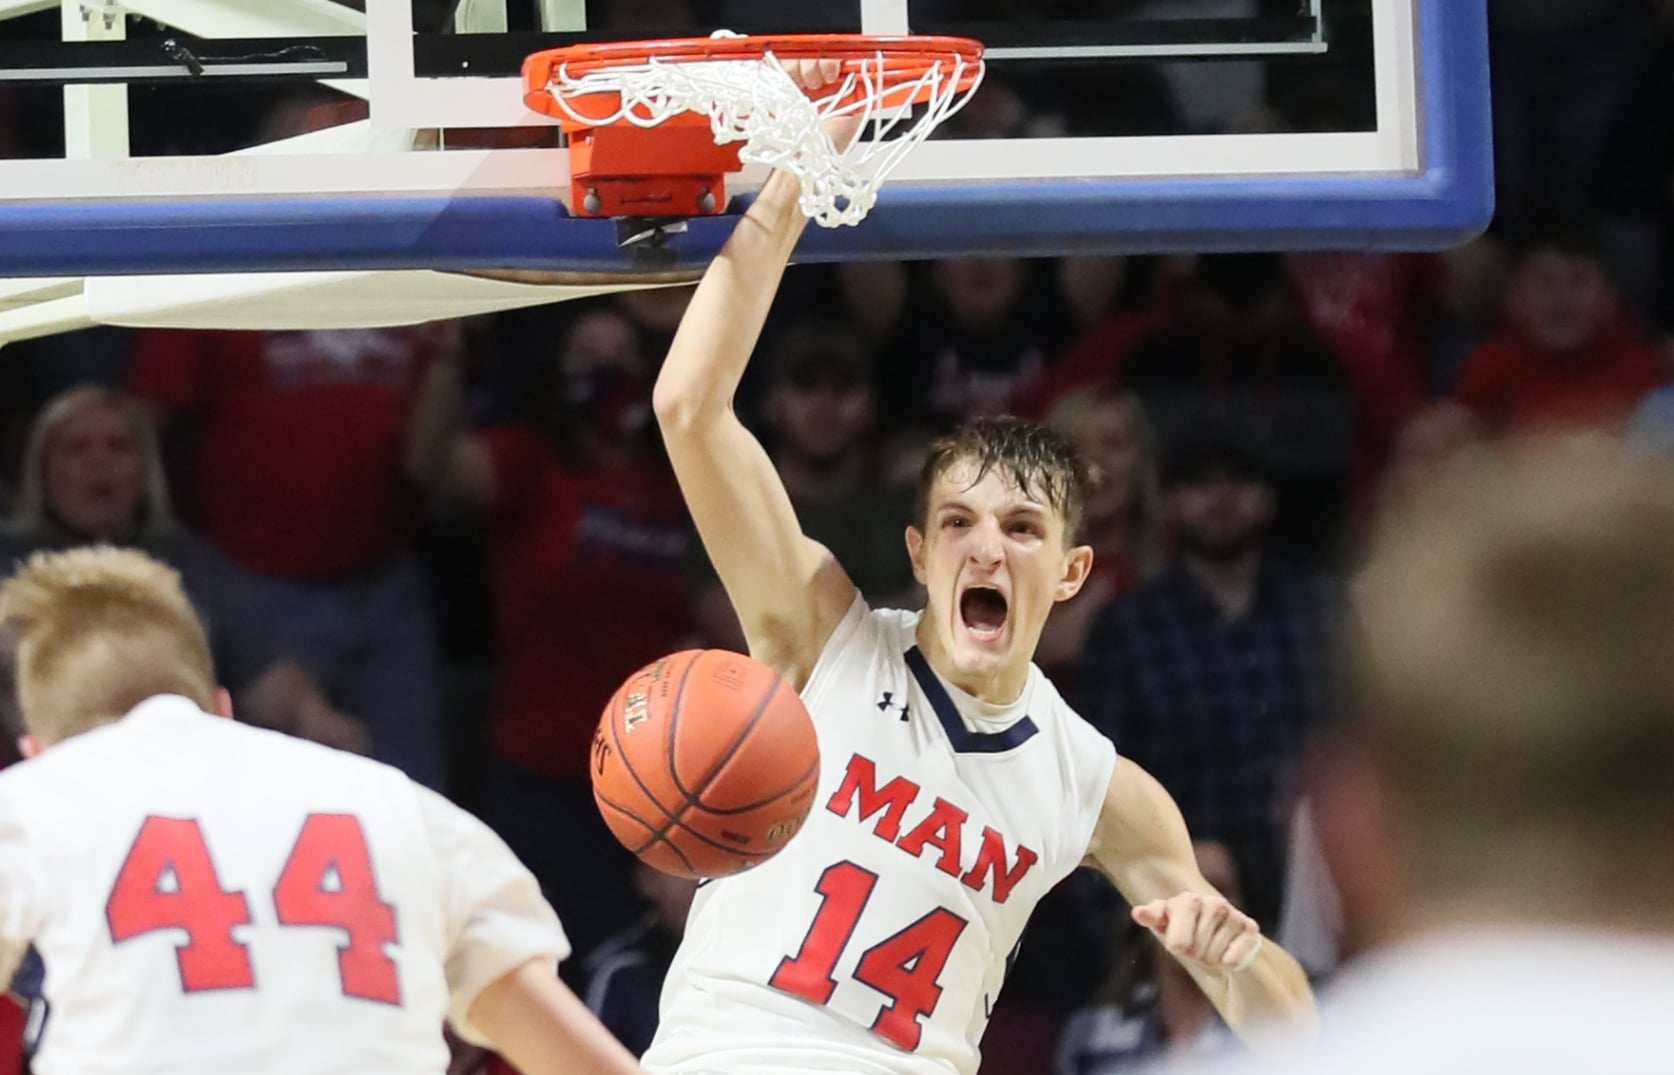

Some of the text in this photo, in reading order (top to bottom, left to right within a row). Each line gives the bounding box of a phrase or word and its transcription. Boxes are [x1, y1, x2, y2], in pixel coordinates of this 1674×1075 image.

[104, 812, 403, 1008] 44
[825, 752, 1039, 904] MAN
[767, 859, 970, 1052] 14
